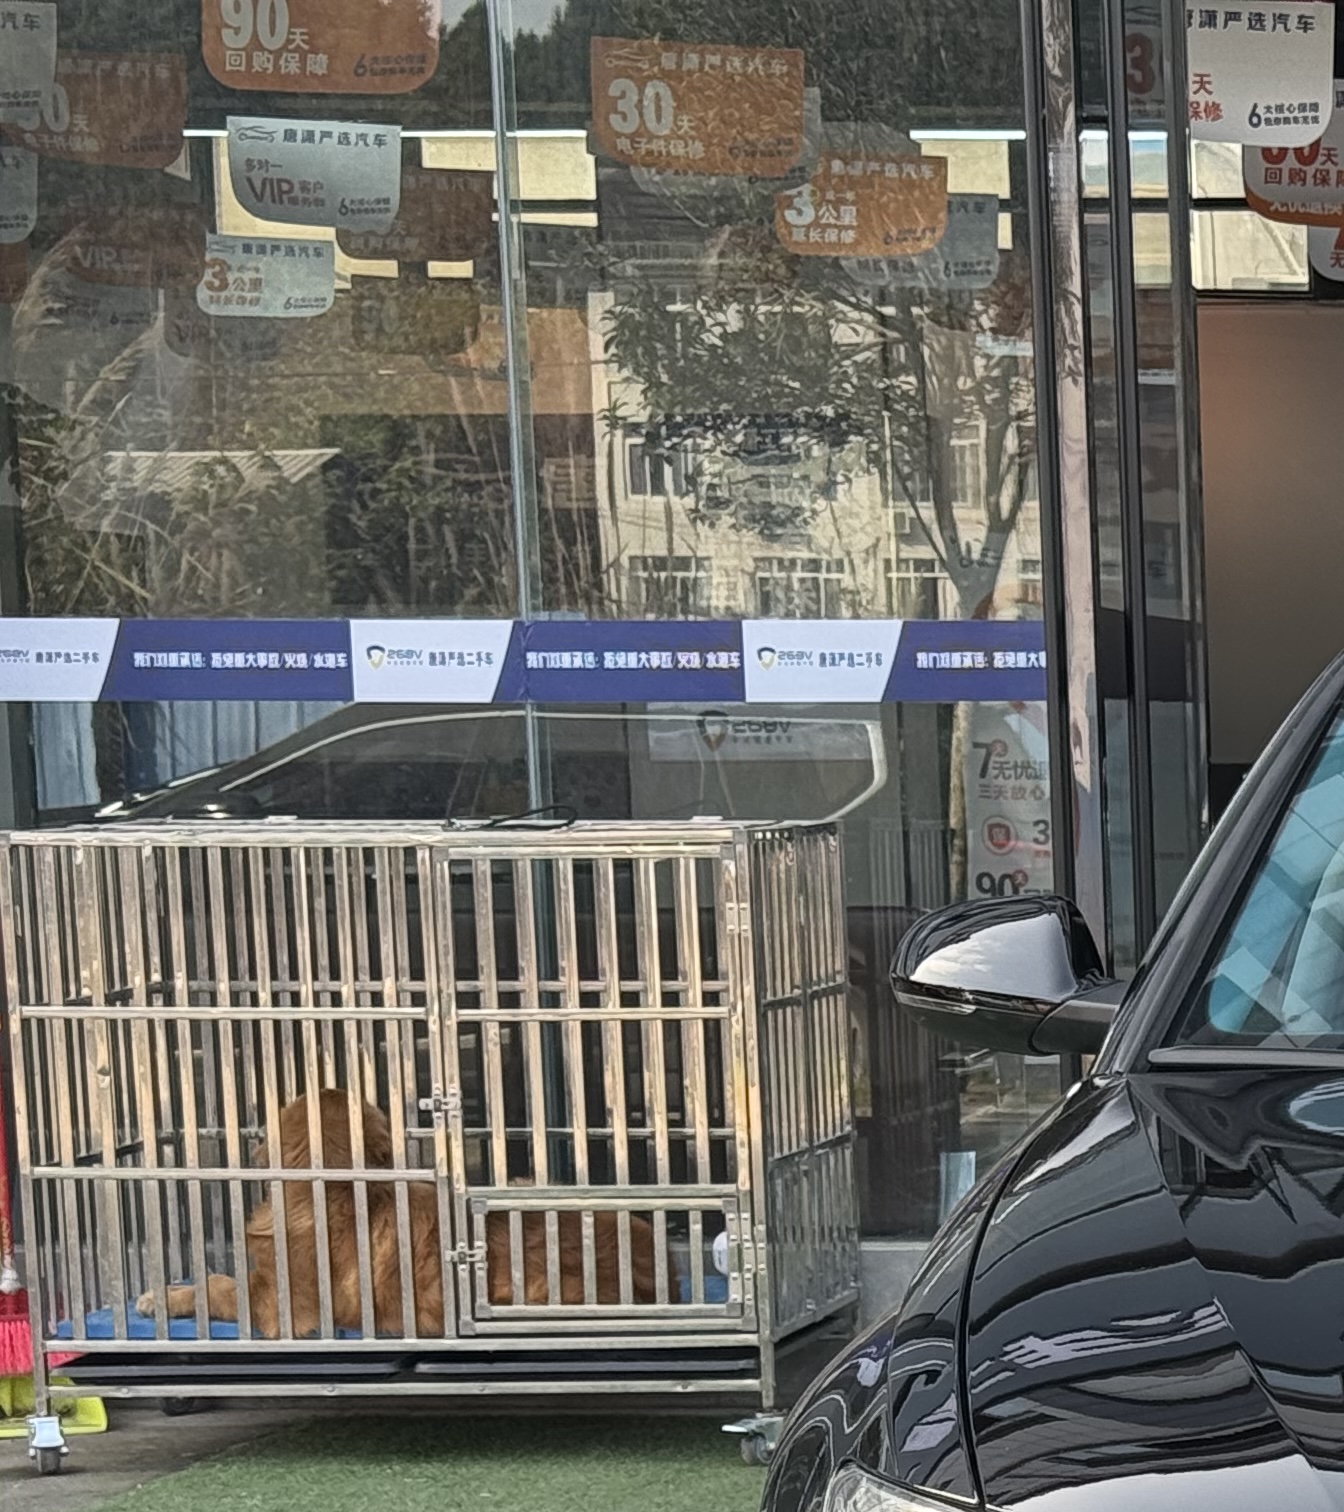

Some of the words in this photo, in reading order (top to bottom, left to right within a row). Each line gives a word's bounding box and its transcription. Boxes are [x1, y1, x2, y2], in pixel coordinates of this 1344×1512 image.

[225, 50, 328, 77] 回购保障
[608, 77, 698, 136] 30天
[246, 177, 294, 205] VIP
